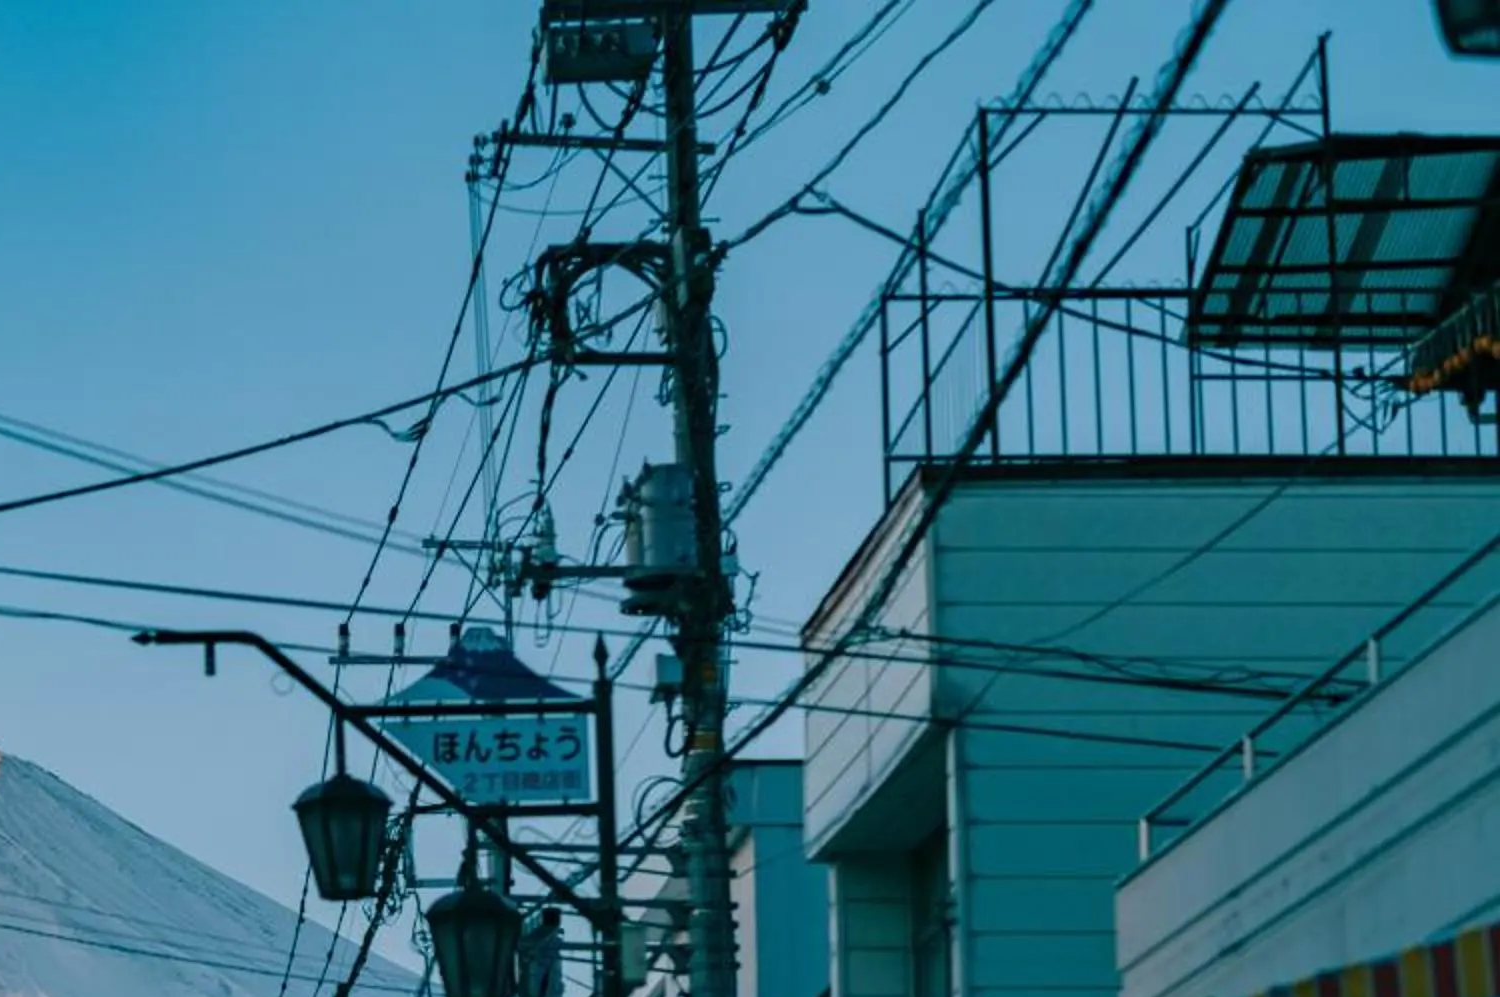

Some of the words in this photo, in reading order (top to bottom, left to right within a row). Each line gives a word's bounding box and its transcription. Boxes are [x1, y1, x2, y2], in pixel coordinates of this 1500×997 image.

[433, 725, 581, 765] ほんちょう
